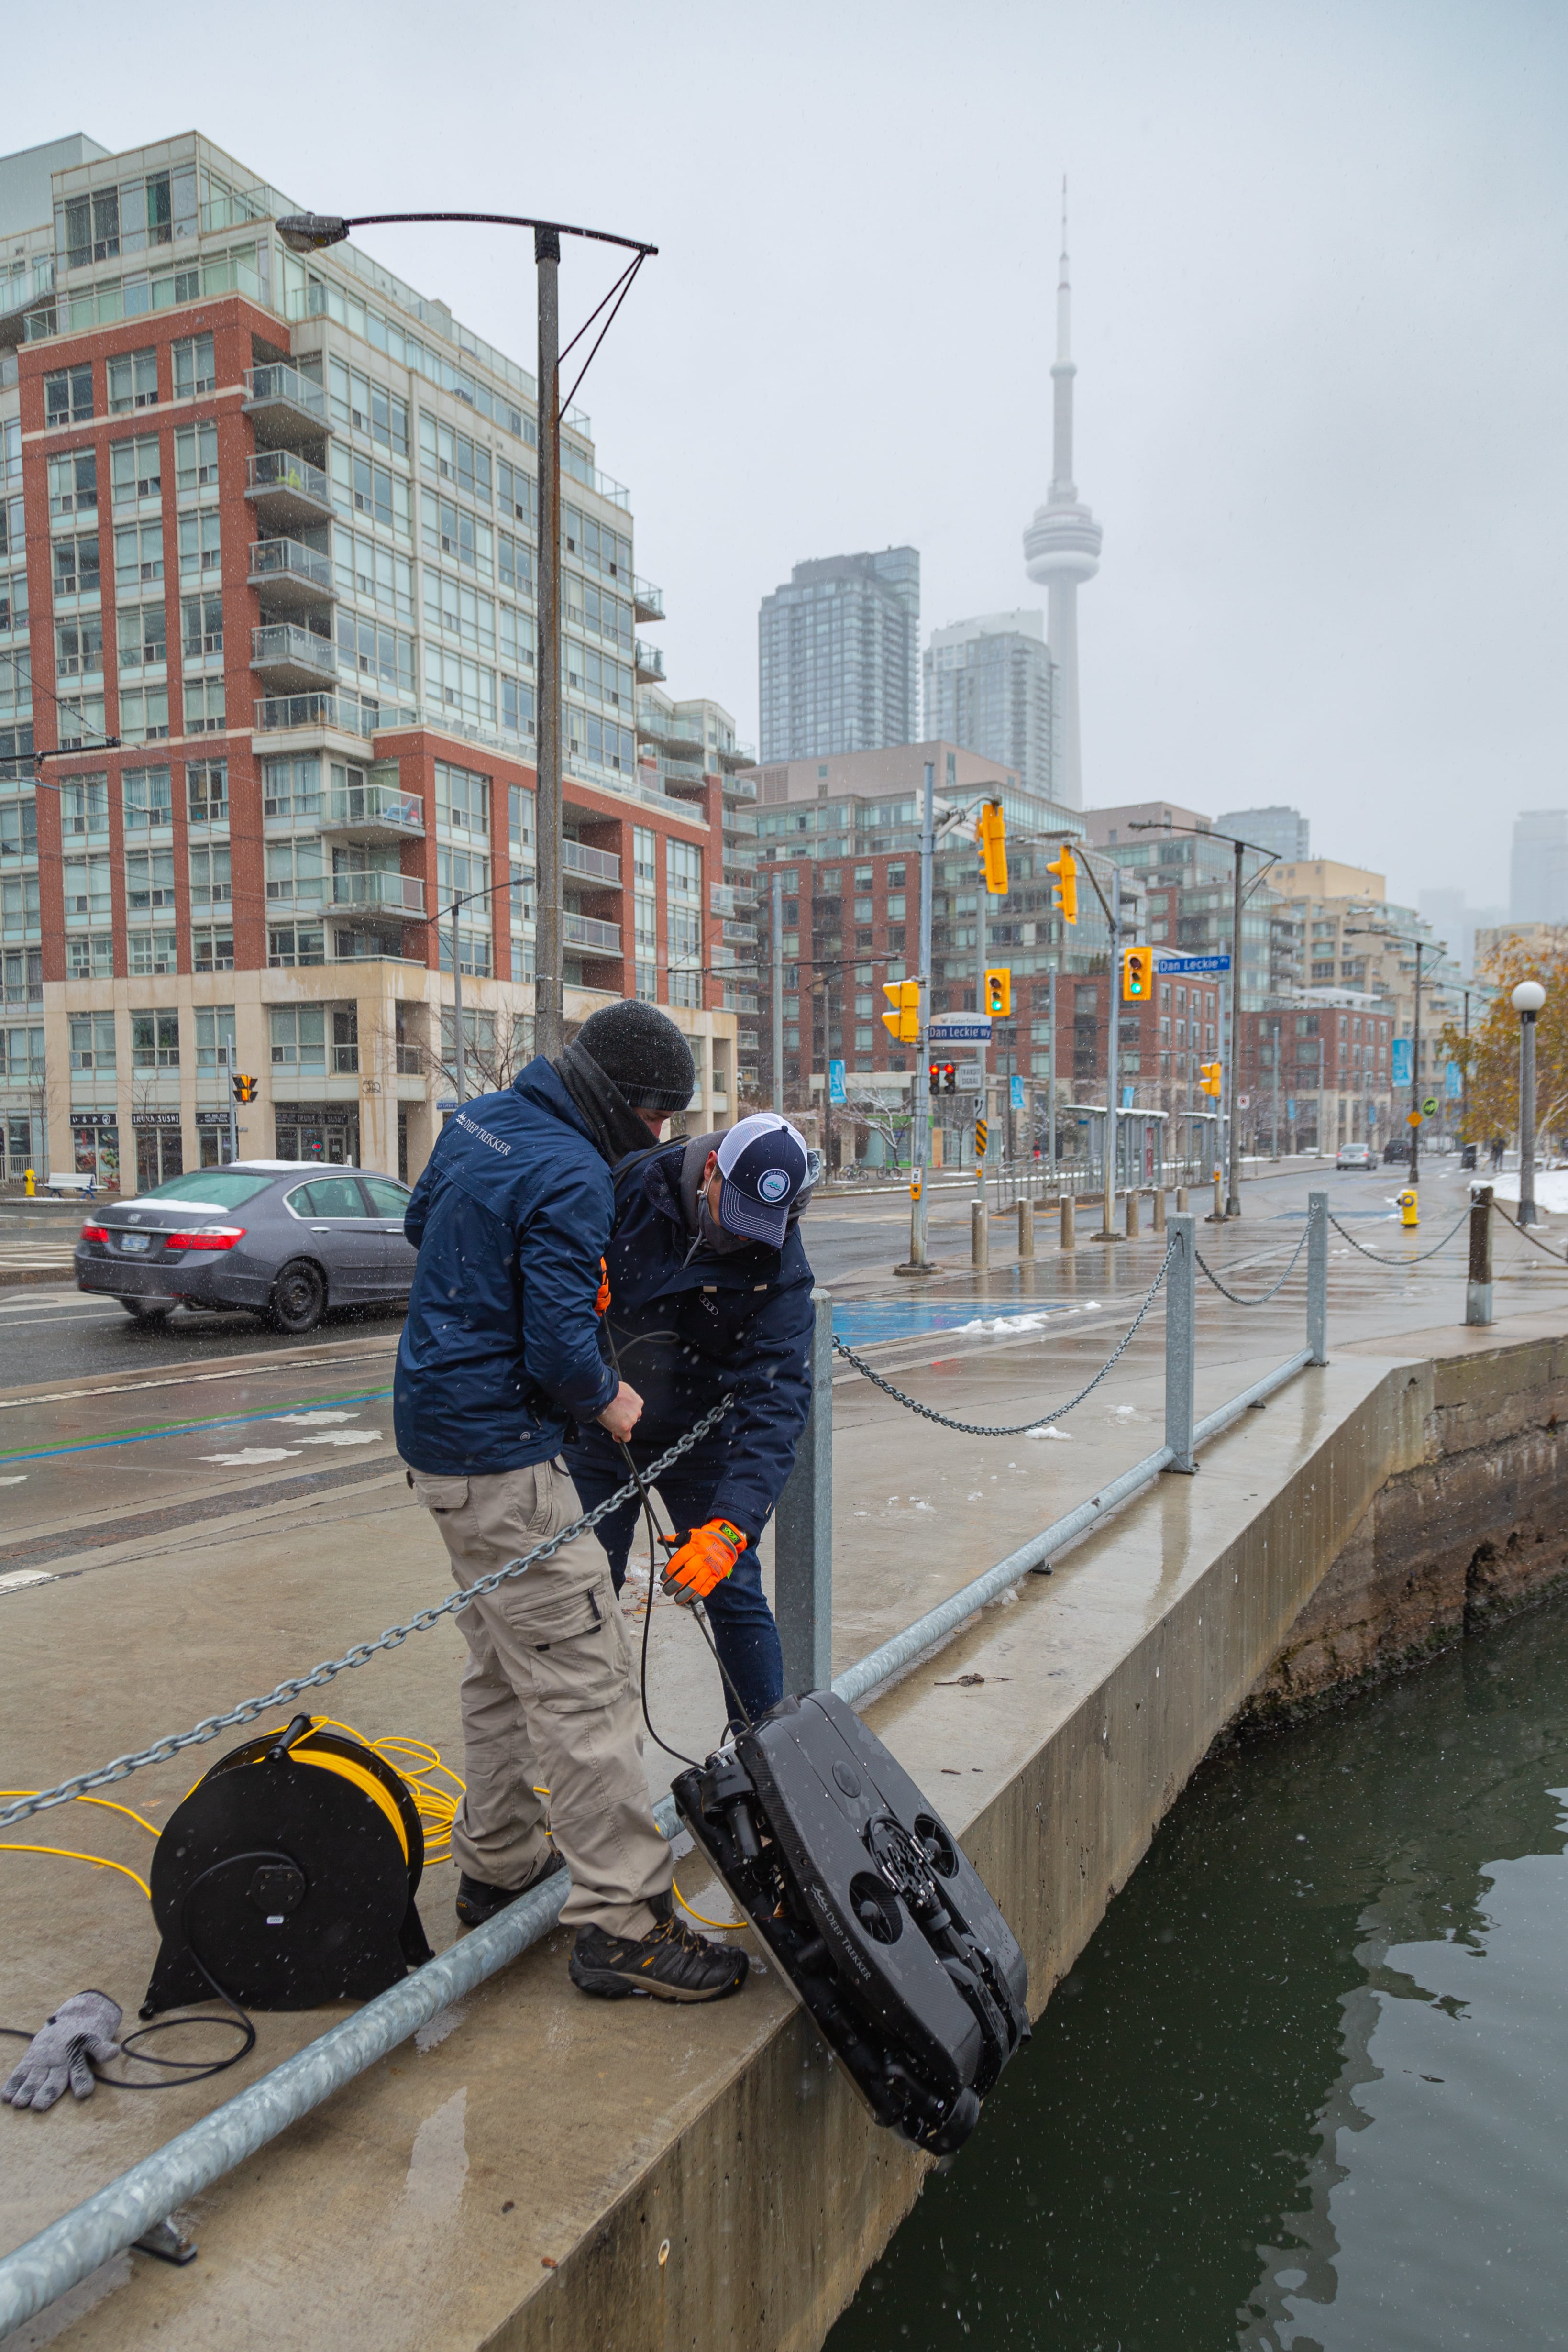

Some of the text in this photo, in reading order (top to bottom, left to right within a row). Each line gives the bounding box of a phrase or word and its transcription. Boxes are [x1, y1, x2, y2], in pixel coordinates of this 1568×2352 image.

[1160, 960, 1180, 972] Dan
[1184, 958, 1219, 970] Leckie
[930, 1027, 991, 1038] Dan Leckie Wy
[463, 1119, 511, 1156] DEEP TREKKER
[826, 1911, 871, 1981] DEEP TREKKER
